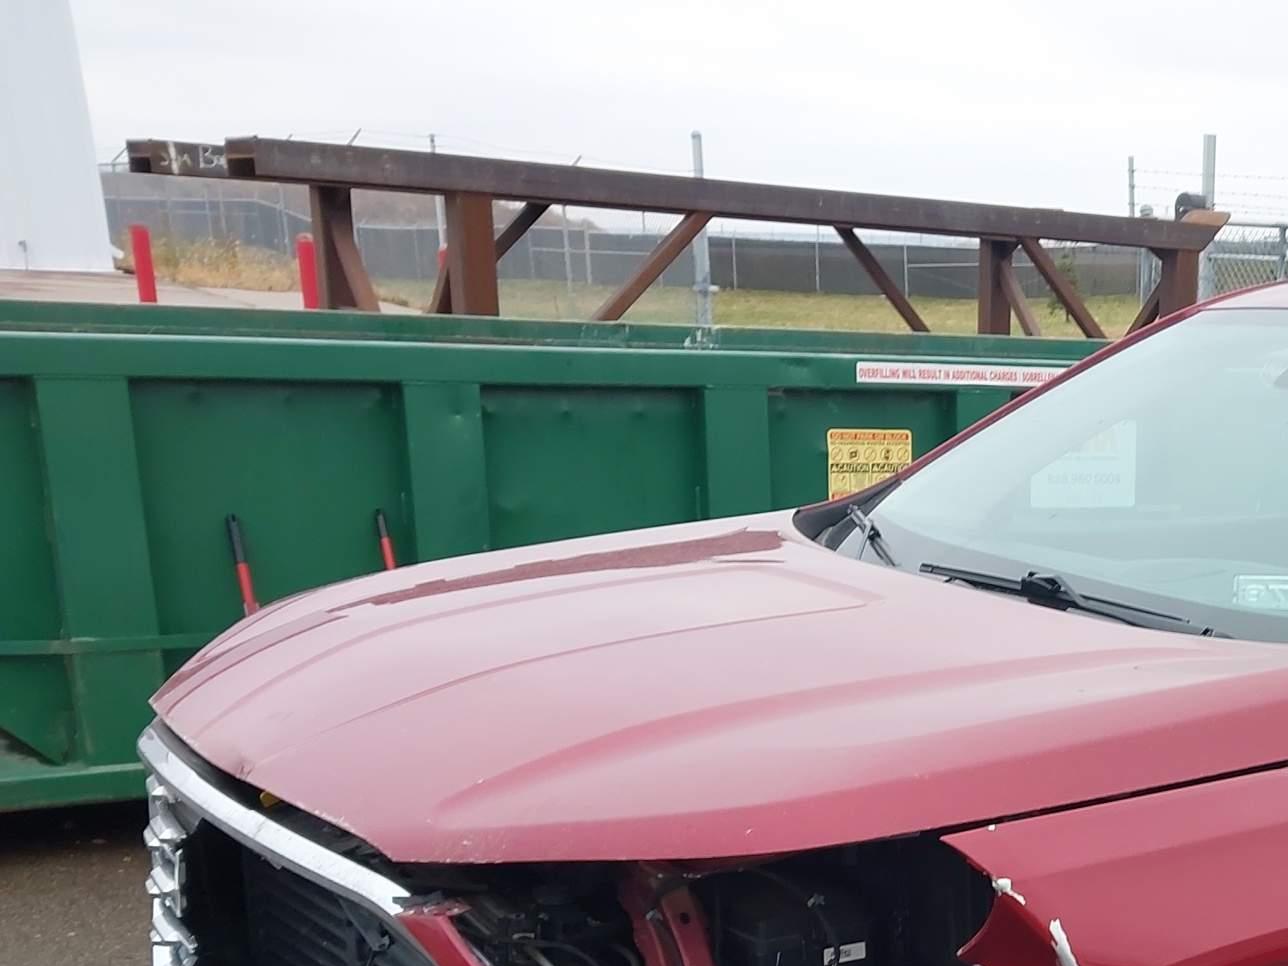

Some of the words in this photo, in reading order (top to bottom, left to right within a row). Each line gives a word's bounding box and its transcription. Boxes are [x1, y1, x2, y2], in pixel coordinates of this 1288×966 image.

[859, 367, 900, 379] OVERFILLING
[902, 367, 916, 379] WILL
[918, 368, 942, 380] RESULT
[952, 369, 987, 381] ADDITIONAL
[989, 370, 1018, 382] CHARGES
